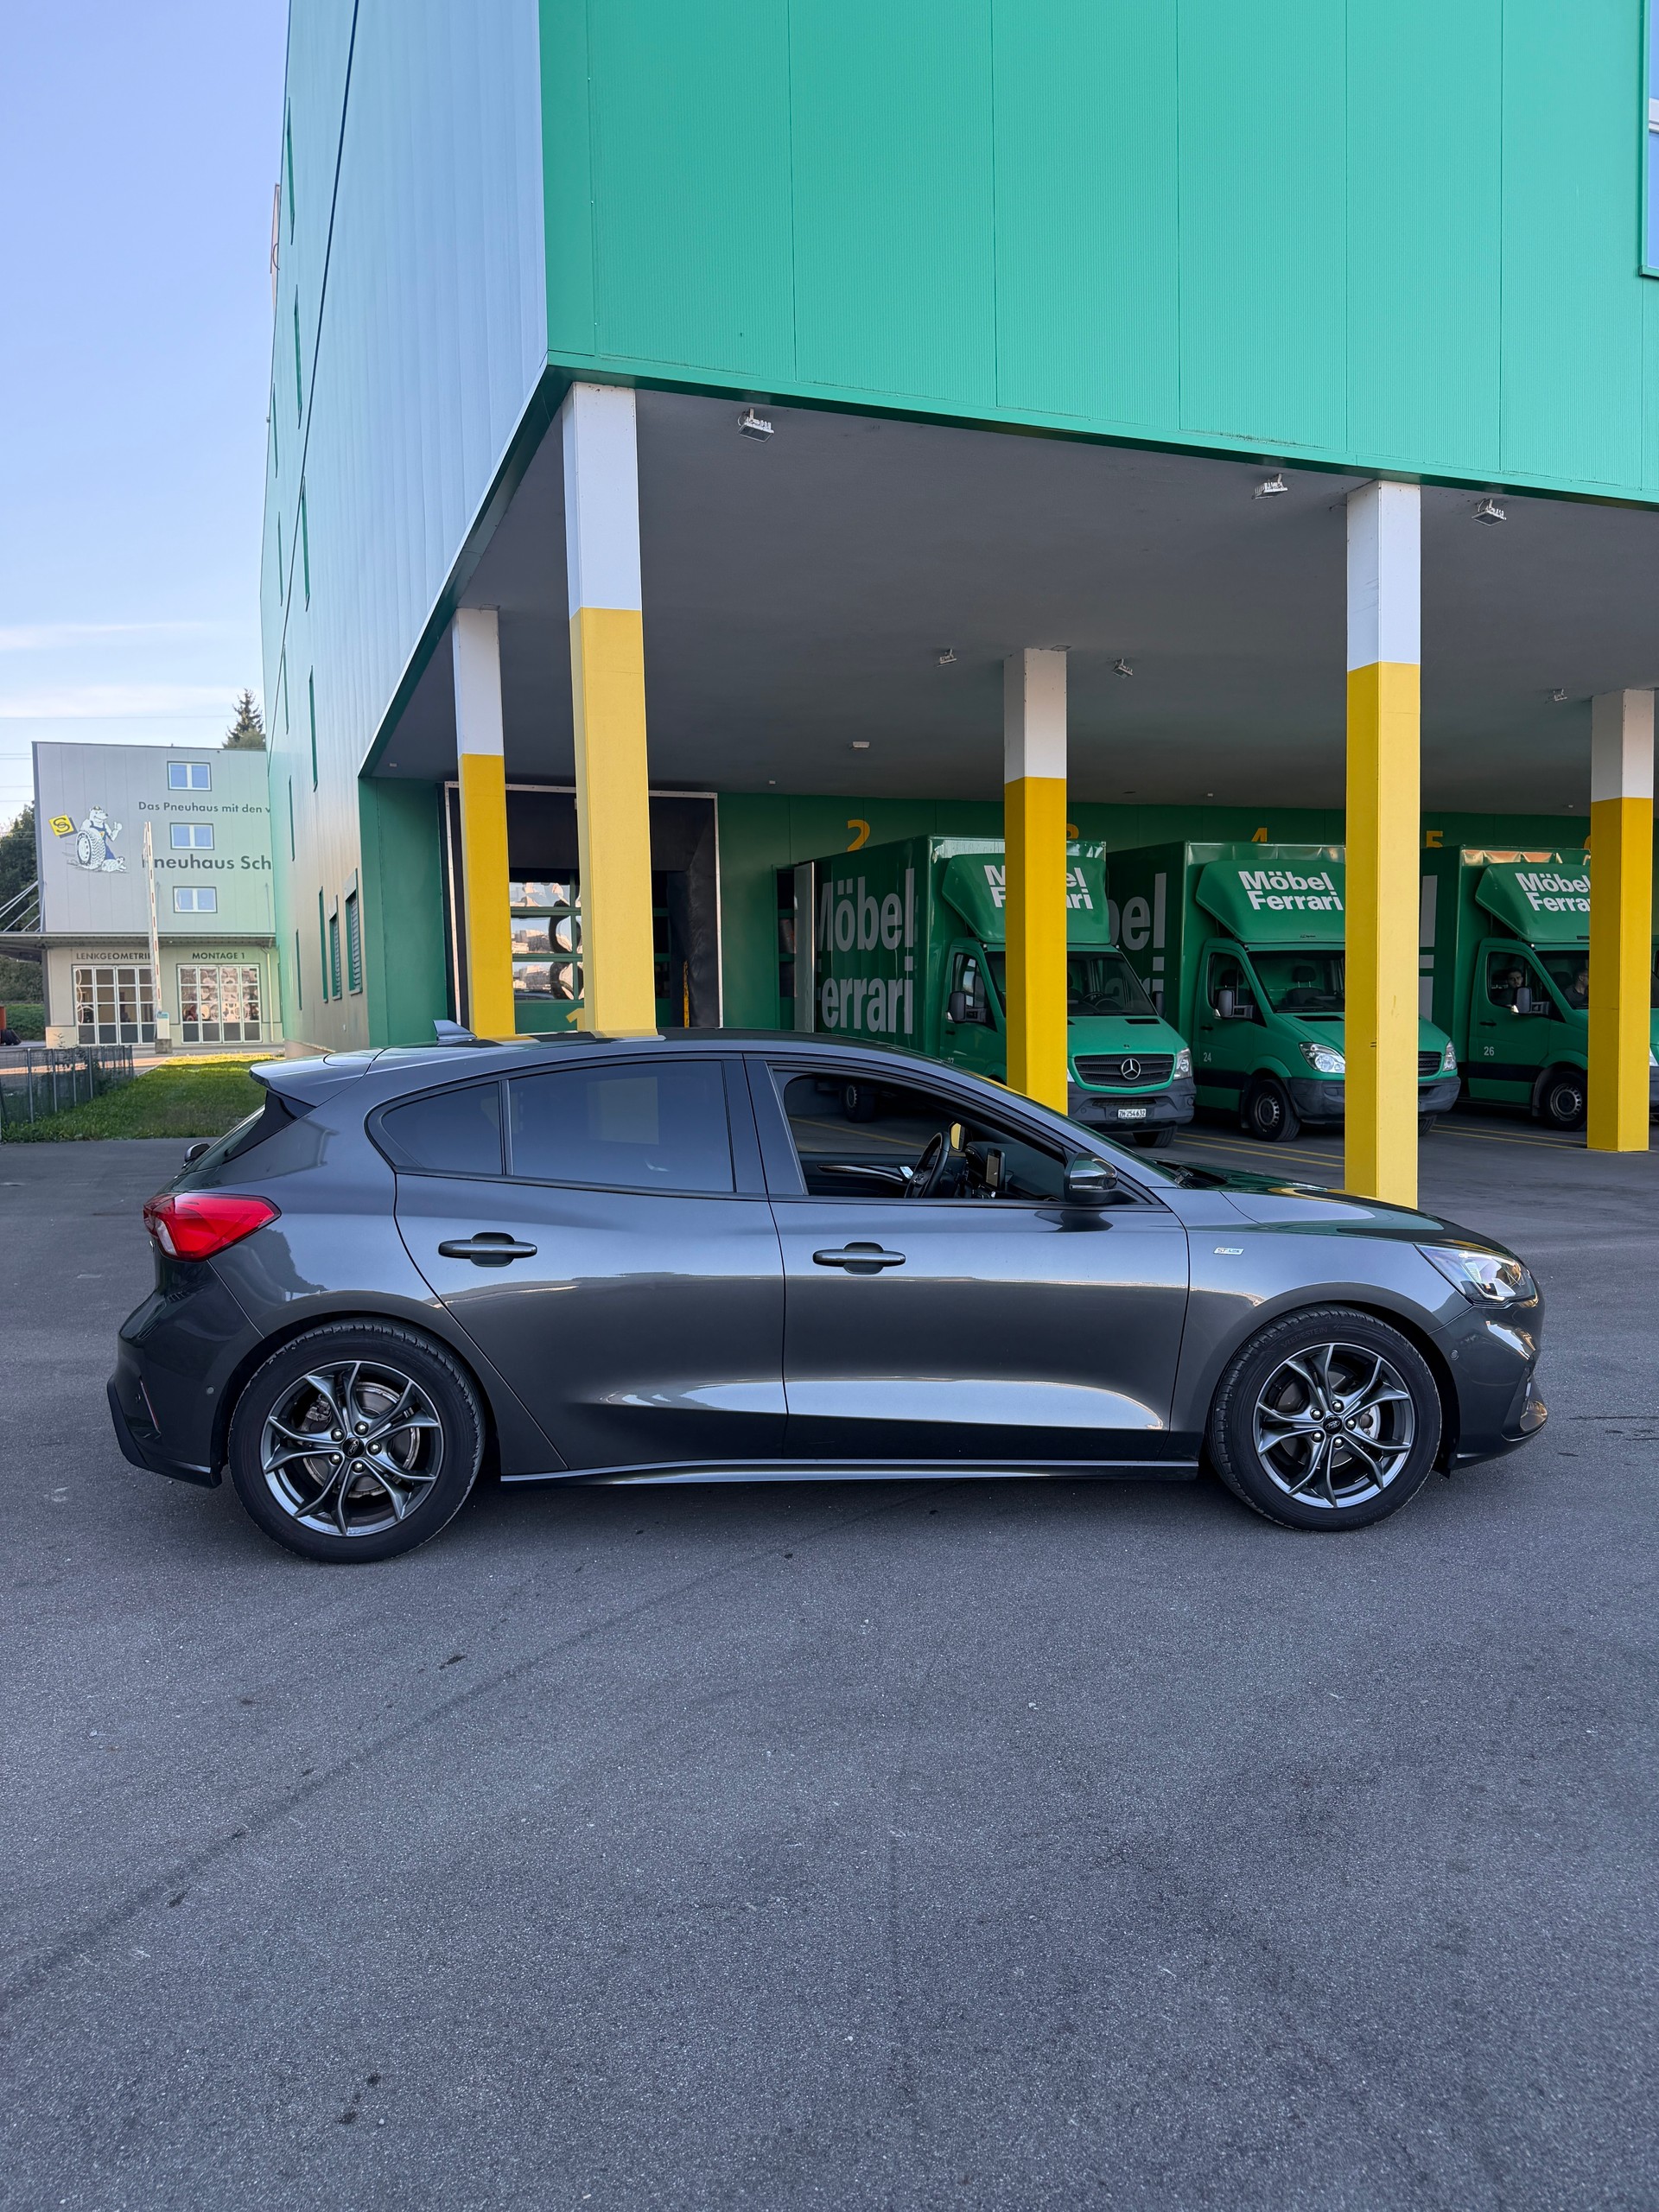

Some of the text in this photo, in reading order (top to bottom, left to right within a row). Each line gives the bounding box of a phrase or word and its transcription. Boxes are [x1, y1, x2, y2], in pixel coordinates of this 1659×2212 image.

[138, 801, 160, 810] Das
[163, 802, 219, 812] Pneuhaus
[221, 804, 238, 813] mit
[242, 804, 262, 813] den
[847, 819, 871, 852] 2
[240, 855, 272, 870] Sch
[1237, 871, 1335, 891] Möbel
[1246, 890, 1344, 911] Ferrari
[1525, 892, 1591, 912] Ferra
[816, 956, 913, 1035] errari
[1203, 1052, 1211, 1062] 24
[1484, 1046, 1495, 1056] 26
